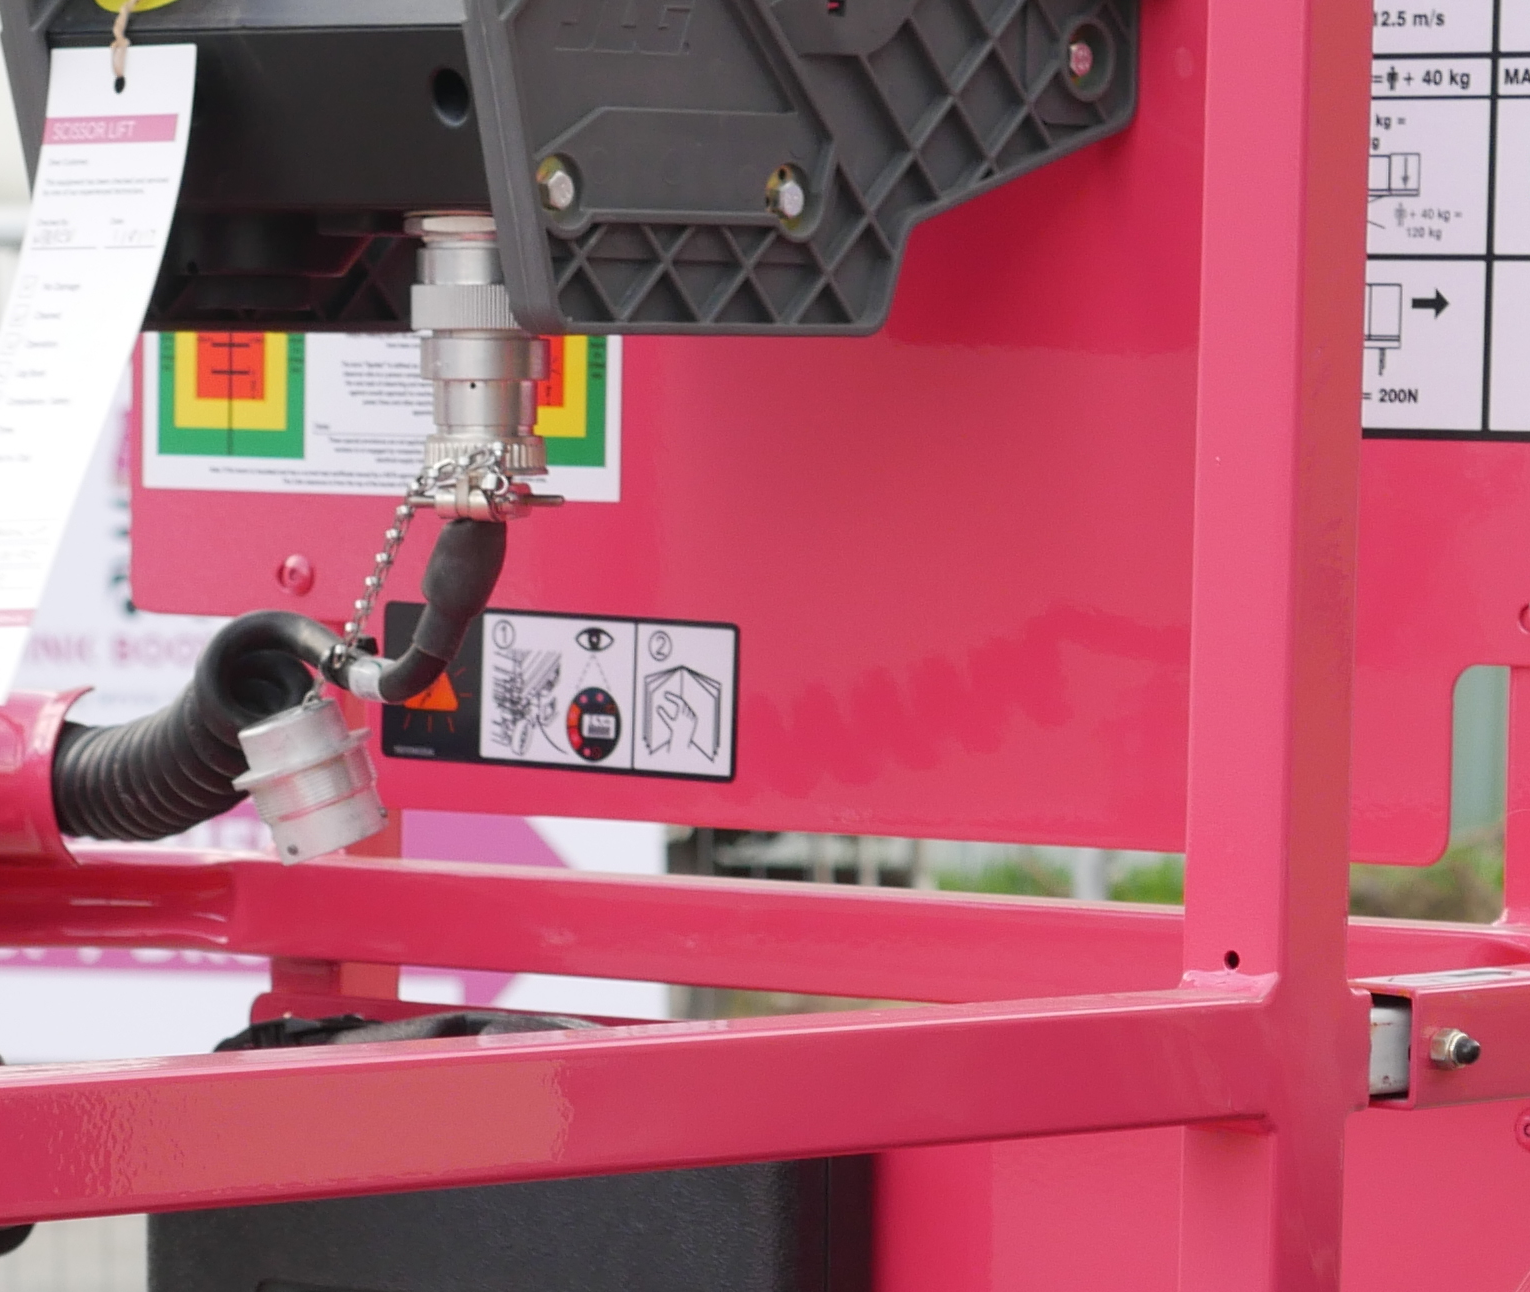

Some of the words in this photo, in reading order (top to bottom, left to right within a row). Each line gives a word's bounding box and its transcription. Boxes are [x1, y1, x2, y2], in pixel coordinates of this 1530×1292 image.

[1413, 8, 1445, 28] m/s
[1422, 69, 1443, 86] 40
[1449, 68, 1470, 90] kg
[52, 120, 105, 141] SCISSOR
[108, 119, 136, 139] LIFT
[1421, 208, 1435, 220] 40
[1437, 207, 1451, 223] kg
[1407, 226, 1425, 238] 120
[1429, 226, 1442, 241] kg
[1379, 388, 1419, 404] 200N
